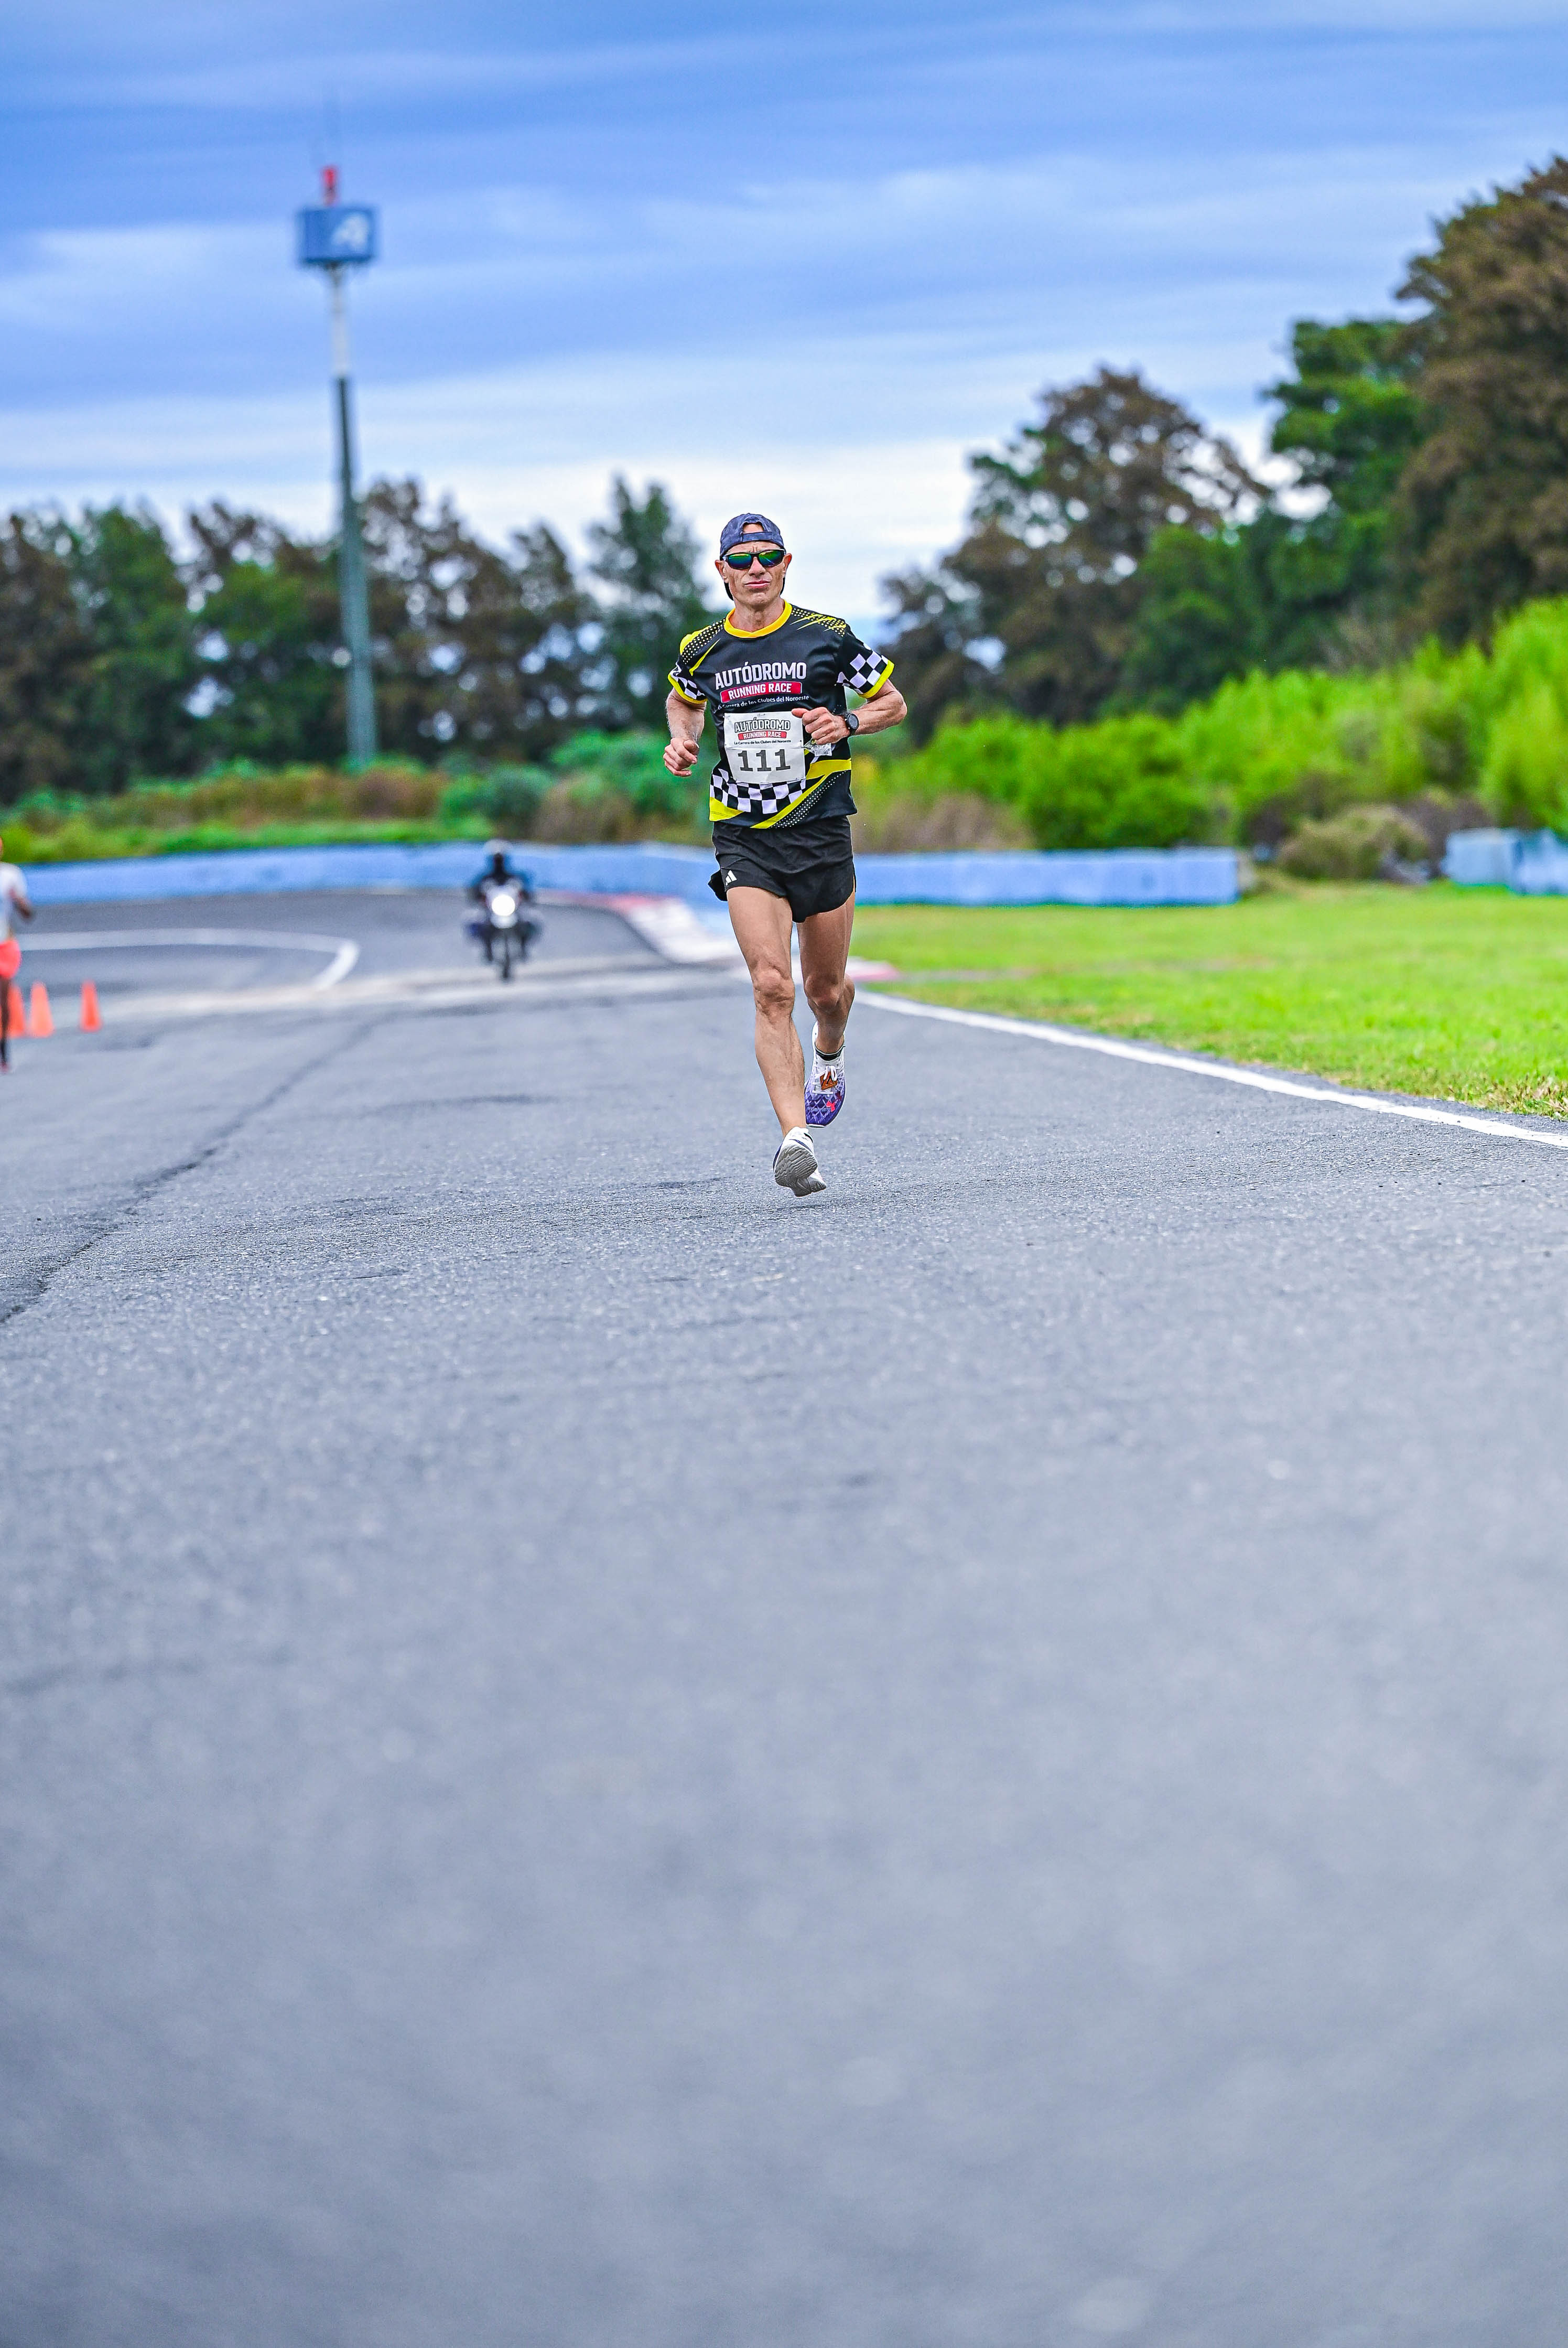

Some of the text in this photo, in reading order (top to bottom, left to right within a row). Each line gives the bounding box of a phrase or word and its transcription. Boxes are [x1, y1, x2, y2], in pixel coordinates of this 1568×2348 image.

[715, 662, 807, 690] AUTÓDROMO
[728, 683, 792, 700] RUNNING RACE
[734, 717, 791, 733] AUTÓDROMO
[738, 749, 791, 772] 111
